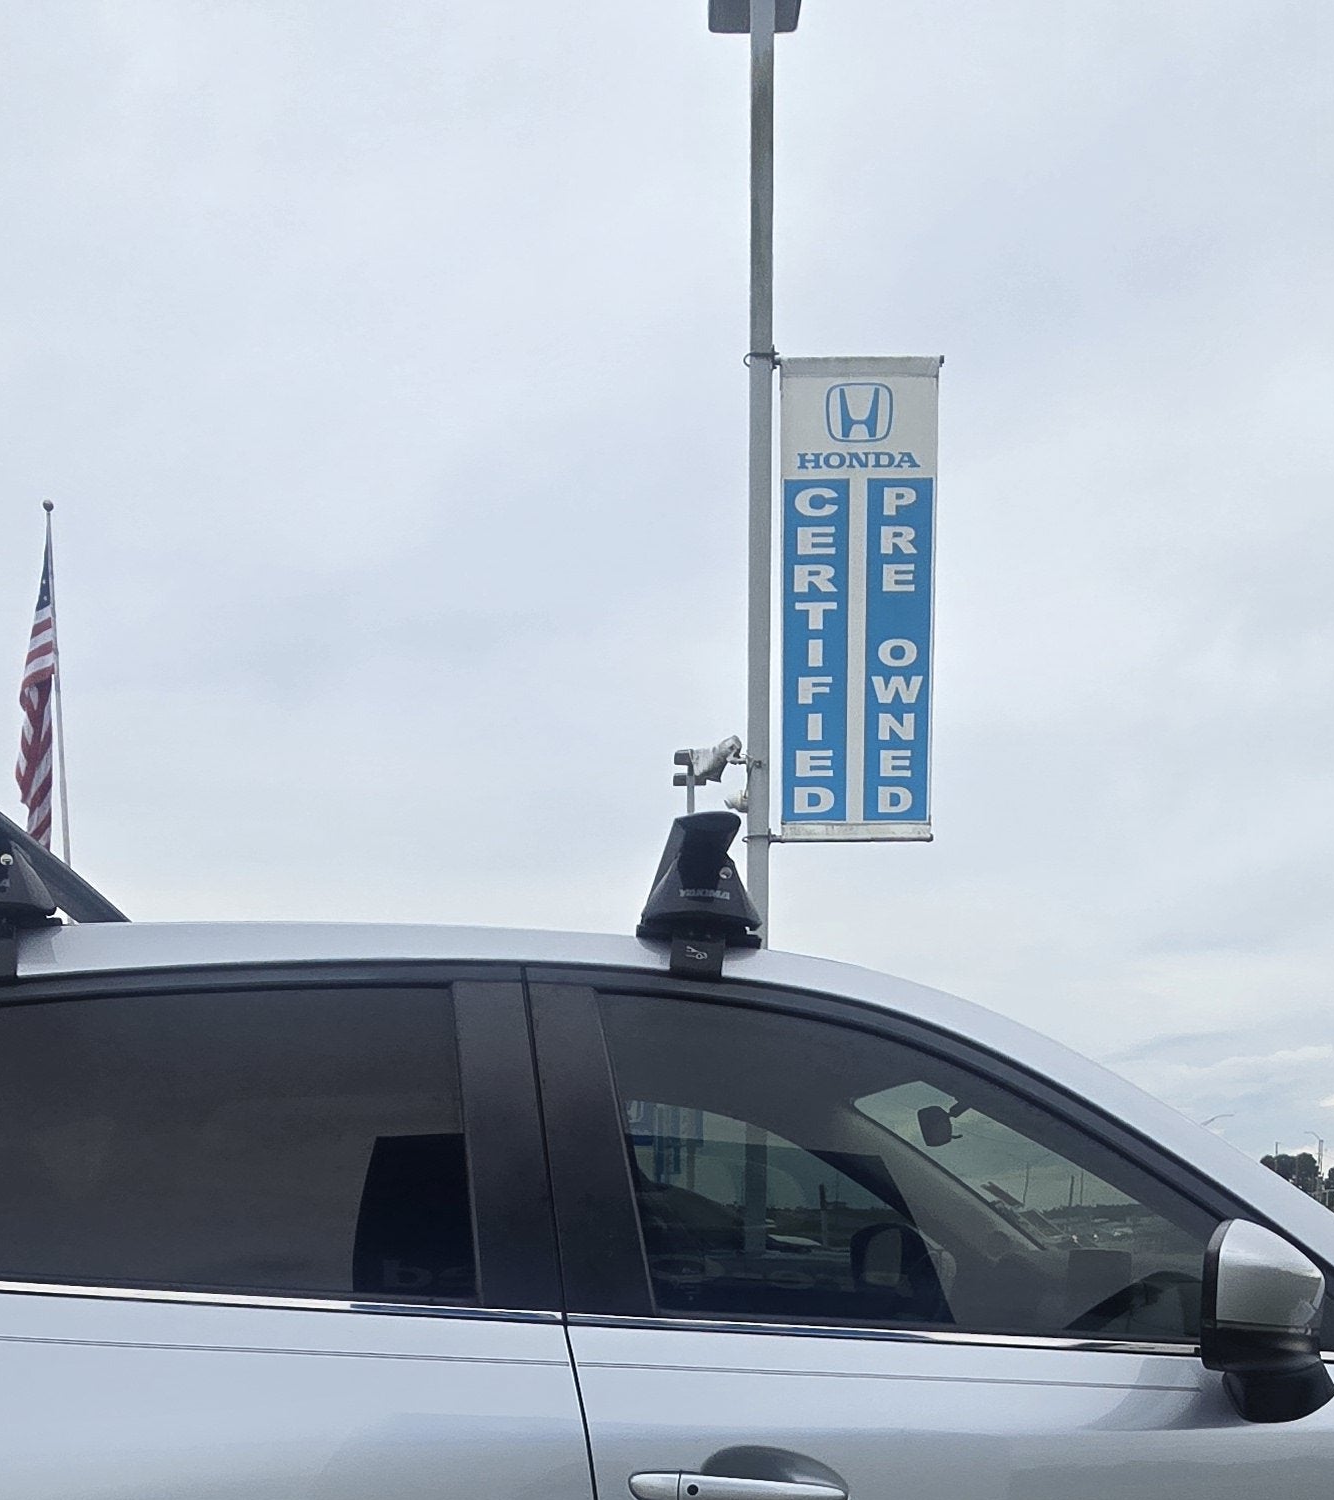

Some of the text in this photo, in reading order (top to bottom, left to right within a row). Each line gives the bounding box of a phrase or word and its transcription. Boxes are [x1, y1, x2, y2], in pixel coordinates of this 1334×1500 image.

[797, 451, 920, 470] HONDA
[793, 487, 838, 814] CERTIFIED
[871, 486, 923, 814] PRE OWNED
